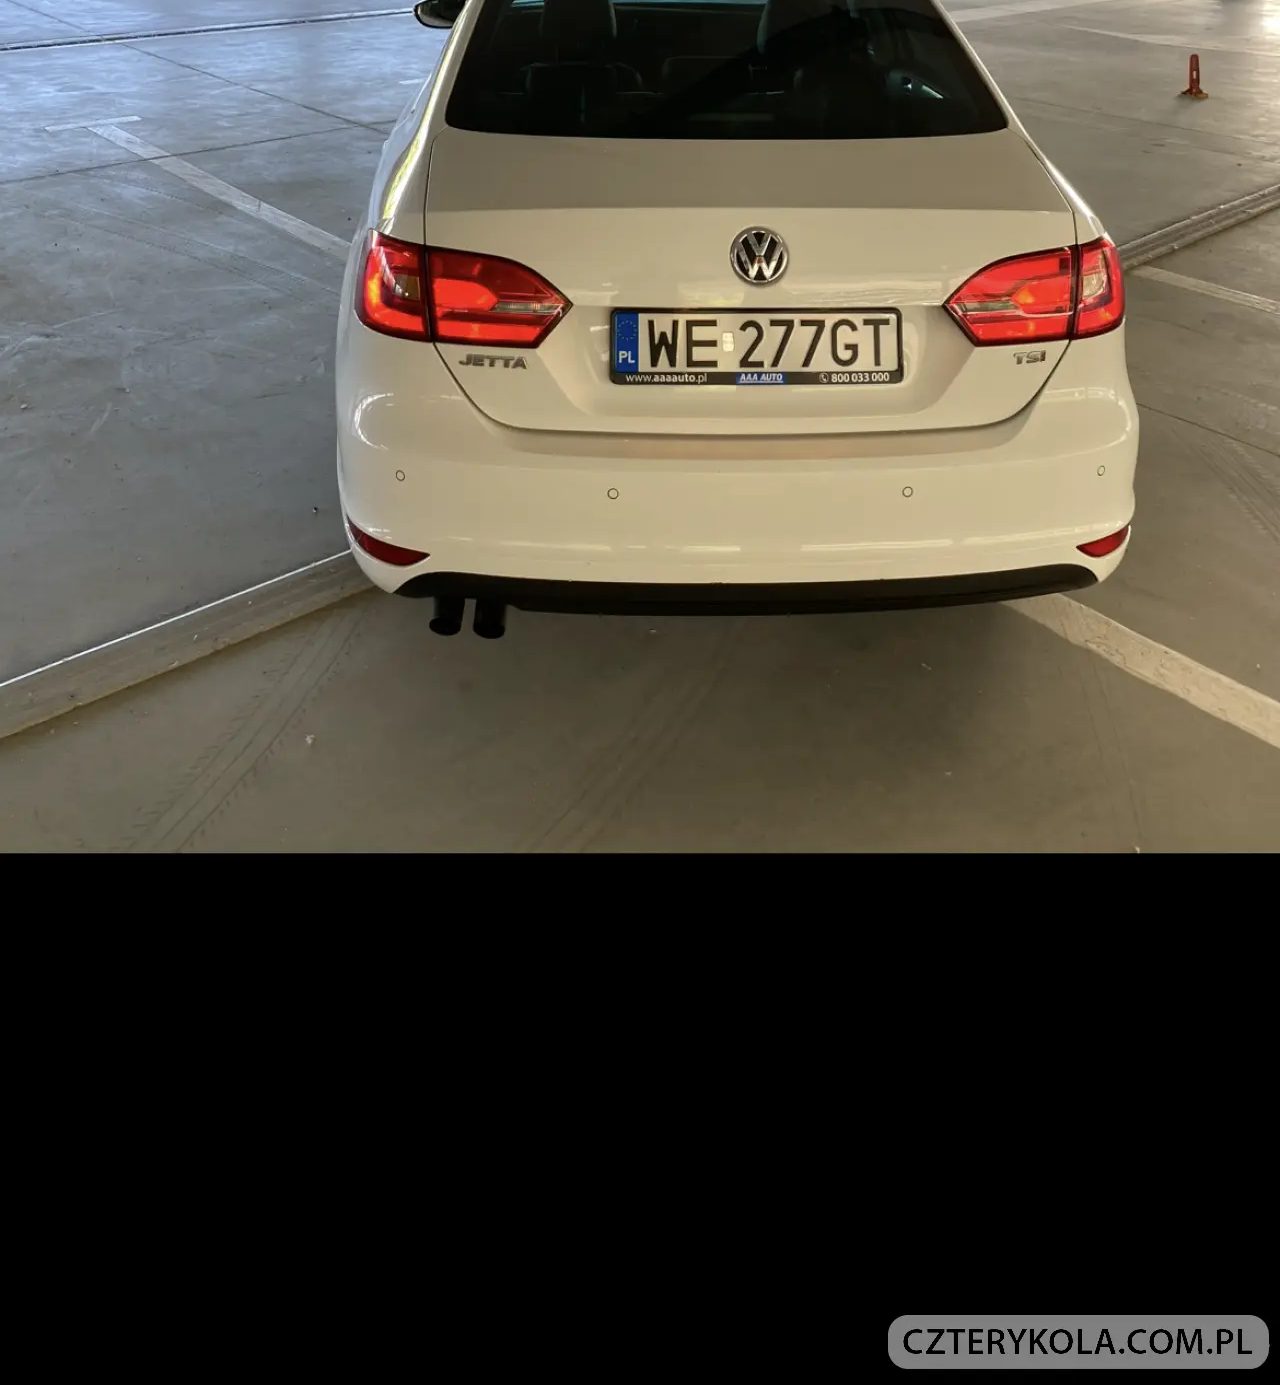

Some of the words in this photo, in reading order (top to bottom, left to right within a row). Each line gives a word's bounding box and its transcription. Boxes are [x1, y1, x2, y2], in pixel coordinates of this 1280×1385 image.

[647, 319, 718, 368] WE
[739, 318, 890, 368] 277GT
[459, 353, 527, 369] JETTA
[618, 350, 636, 364] PL
[1013, 350, 1046, 365] TSI
[625, 372, 708, 384] www.aaaauto.pl
[739, 373, 758, 383] AAA
[760, 373, 783, 383] AUTO
[831, 373, 849, 383] 800
[851, 373, 870, 383] 033
[871, 373, 890, 382] 000
